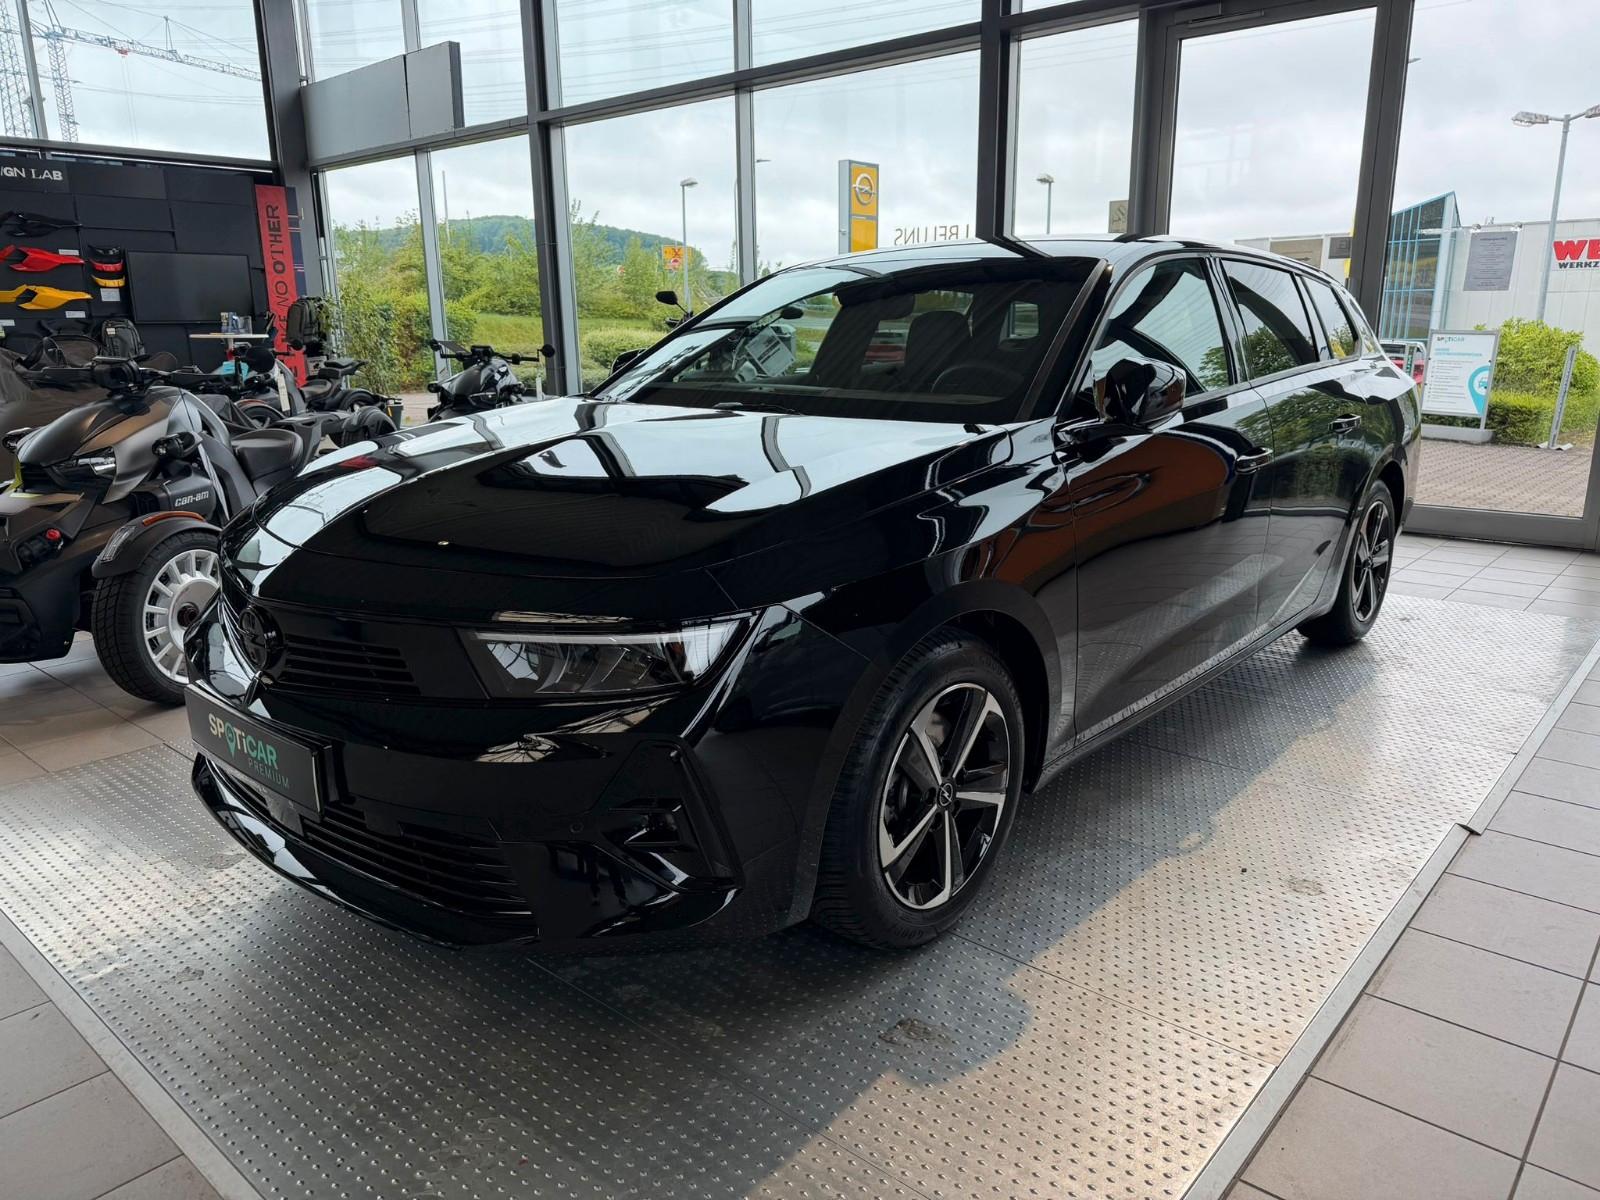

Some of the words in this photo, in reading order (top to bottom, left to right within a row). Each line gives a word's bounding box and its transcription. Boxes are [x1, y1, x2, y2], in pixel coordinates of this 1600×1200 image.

[30, 168, 63, 181] LAB
[266, 204, 286, 275] OTHER
[1558, 261, 1600, 269] WERKZ
[275, 280, 289, 308] NO
[174, 491, 209, 507] can-am
[248, 757, 289, 790] PREMIUM
